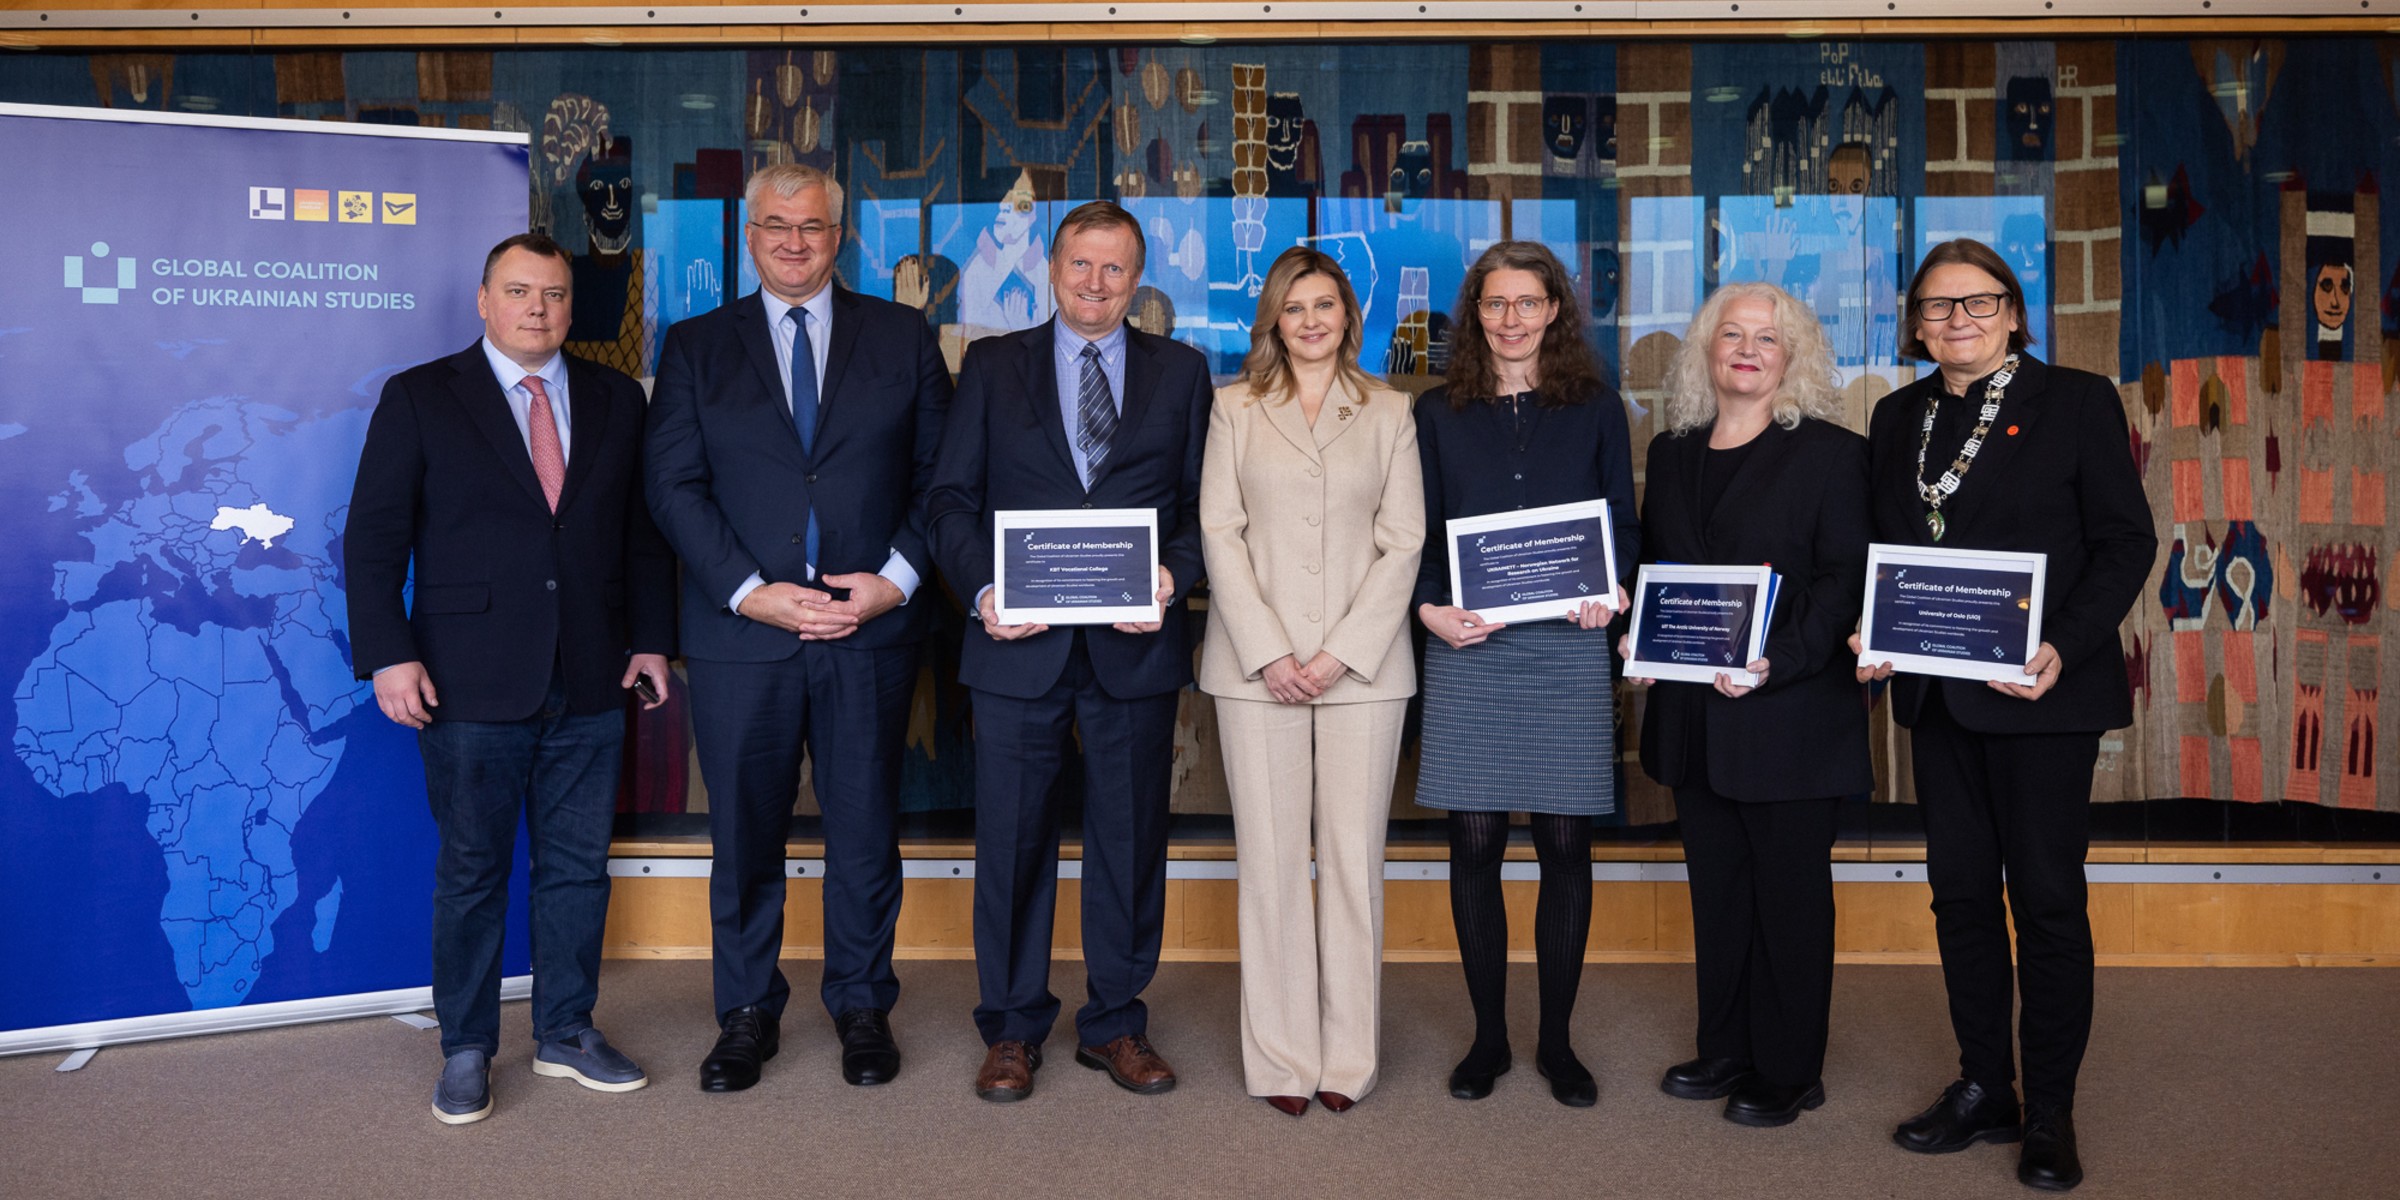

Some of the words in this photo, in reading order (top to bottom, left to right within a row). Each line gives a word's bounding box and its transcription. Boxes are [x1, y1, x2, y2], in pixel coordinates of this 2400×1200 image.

[152, 258, 248, 278] GLOBAL
[254, 260, 378, 281] COALITION
[152, 288, 185, 306] OF
[192, 288, 318, 308] UKRAINIAN
[324, 291, 415, 310] STUDIES
[1027, 542, 1070, 550] Certificate
[1082, 541, 1133, 550] Membership
[1480, 543, 1522, 554] Certificate
[1524, 540, 1533, 548] of
[1534, 534, 1585, 546] Membership
[1898, 581, 1943, 592] Certificate
[1944, 584, 1954, 592] of
[1956, 586, 2011, 598] Membership
[1660, 597, 1692, 605] Certificate
[1701, 599, 1742, 608] Membership
[1919, 610, 1945, 618] University
